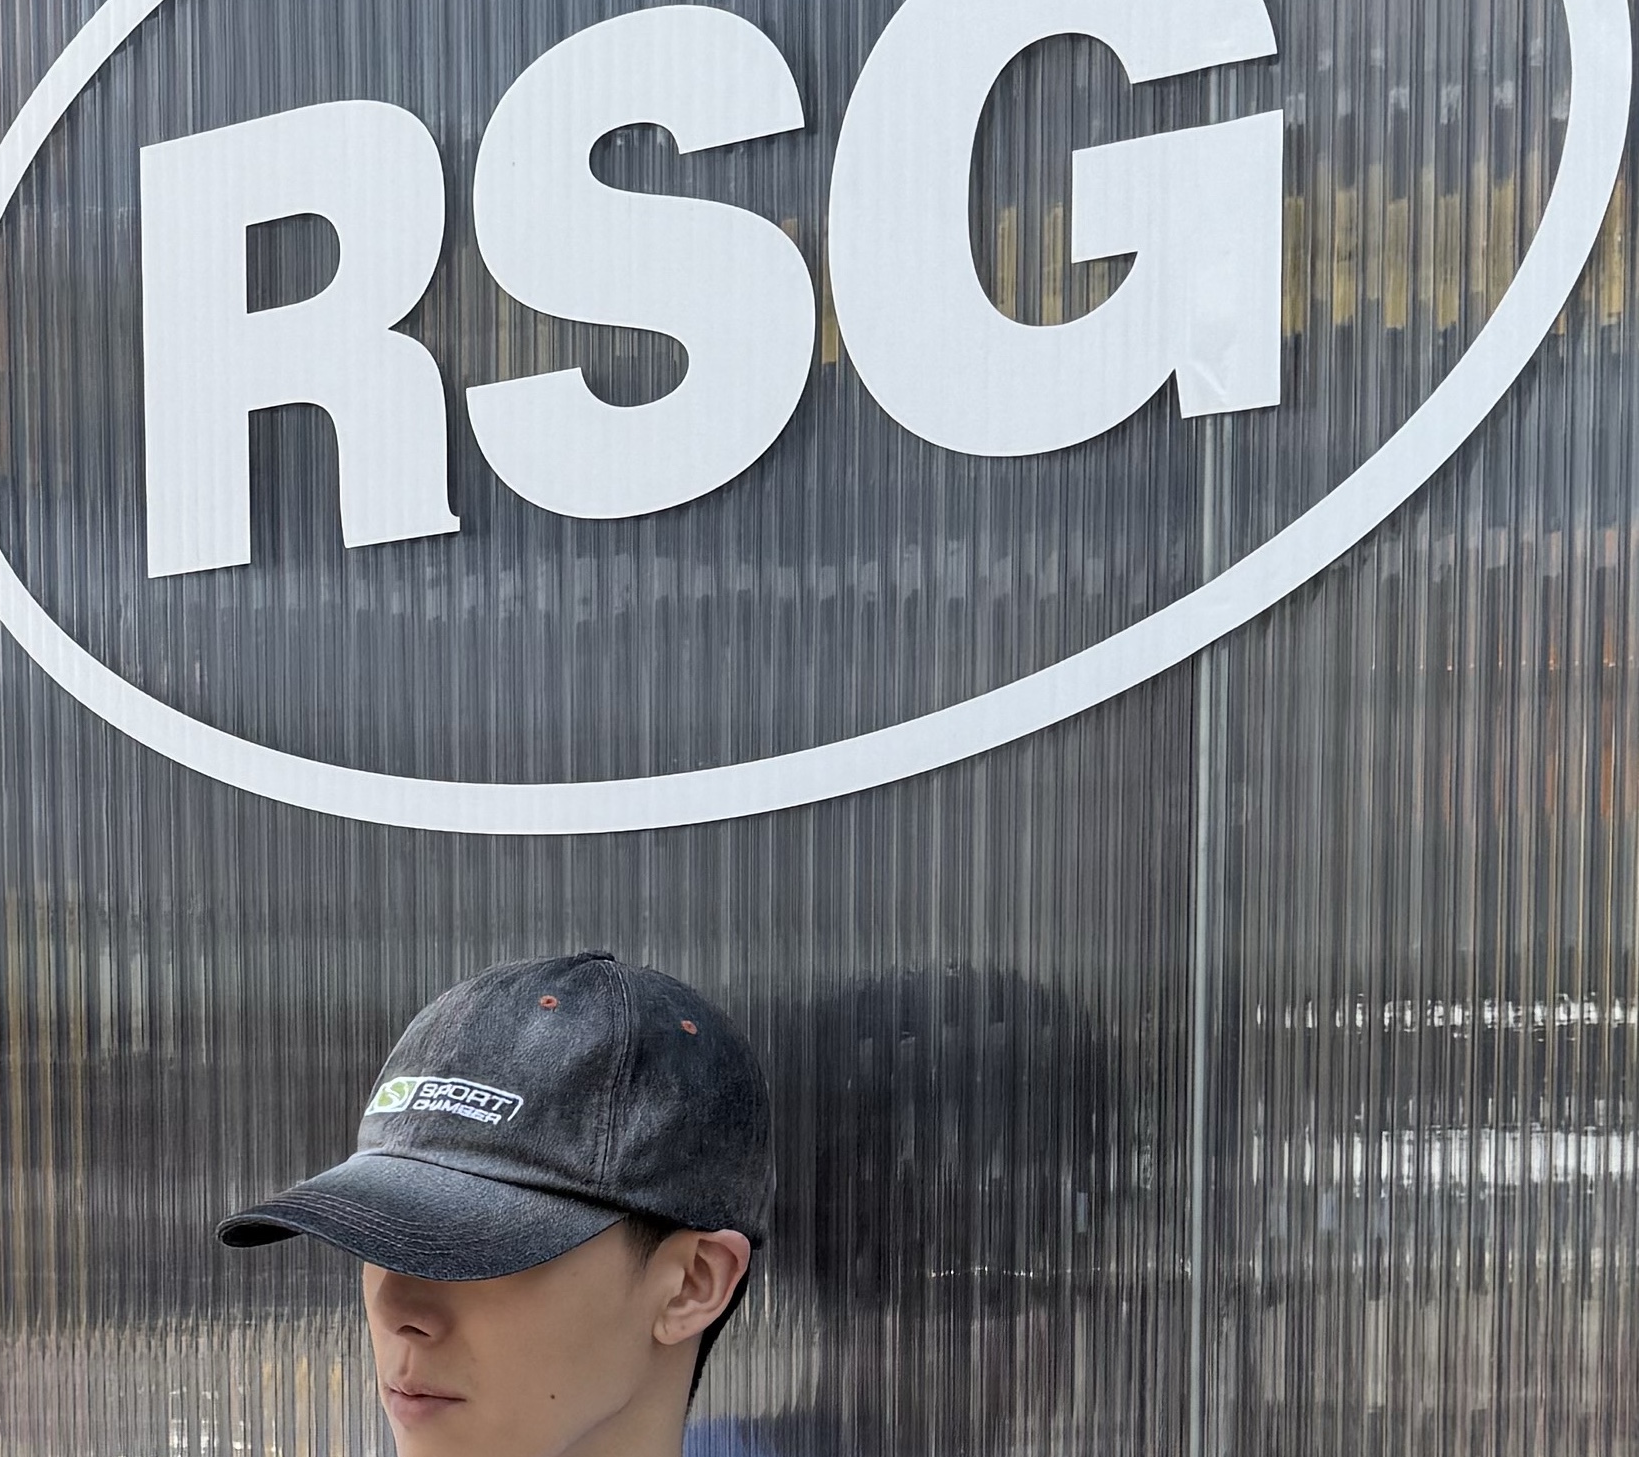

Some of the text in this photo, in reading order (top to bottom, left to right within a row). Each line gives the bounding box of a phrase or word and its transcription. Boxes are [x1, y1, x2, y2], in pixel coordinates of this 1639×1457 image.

[139, 0, 1284, 579] RSG
[419, 1082, 513, 1111] SPORT
[412, 1099, 502, 1125] CHAMBER
